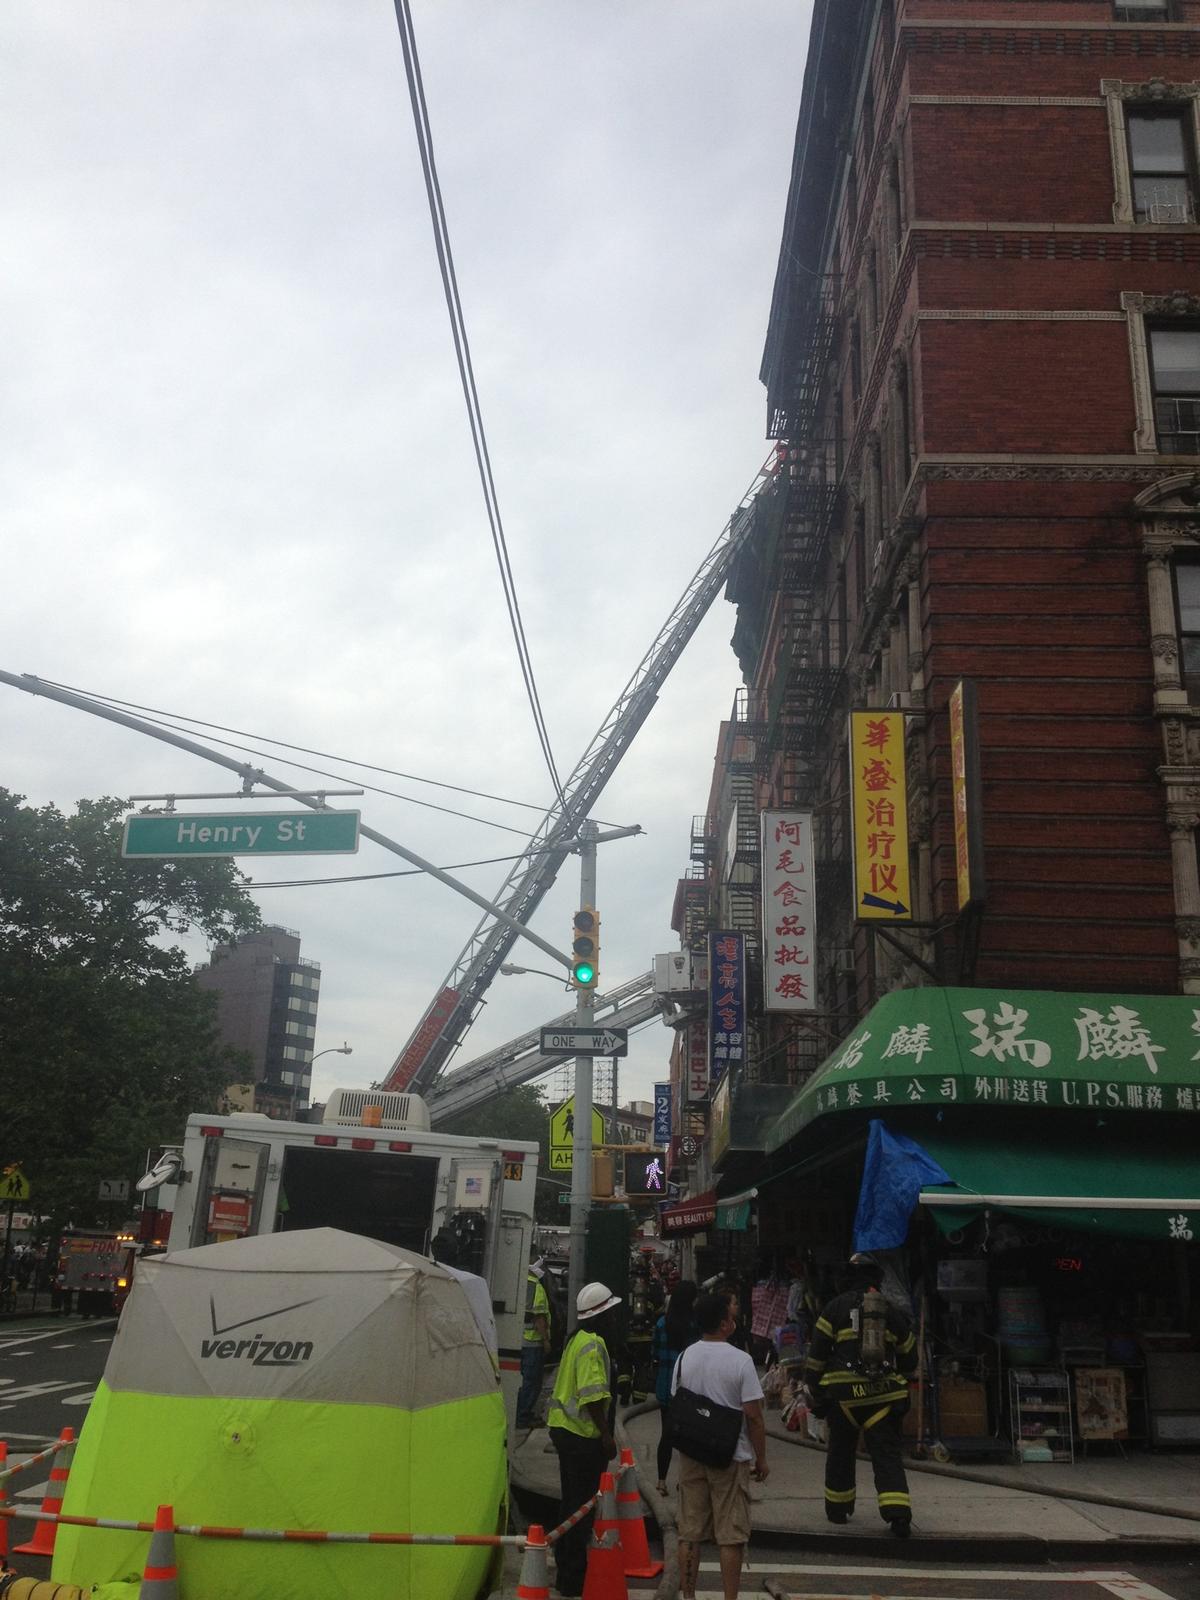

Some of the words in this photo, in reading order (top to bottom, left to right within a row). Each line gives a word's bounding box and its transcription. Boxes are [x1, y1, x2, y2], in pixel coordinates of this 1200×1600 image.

[177, 822, 262, 847] Henry
[277, 820, 307, 842] St
[773, 820, 809, 1000] 阿毛食品批發
[552, 1036, 576, 1047] ONE
[592, 1036, 617, 1047] WAY
[962, 1001, 1200, 1075] 瑞麟
[683, 1212, 705, 1225] BEAUTY
[1168, 1214, 1193, 1241] 瑞
[200, 1334, 313, 1366] verizon
